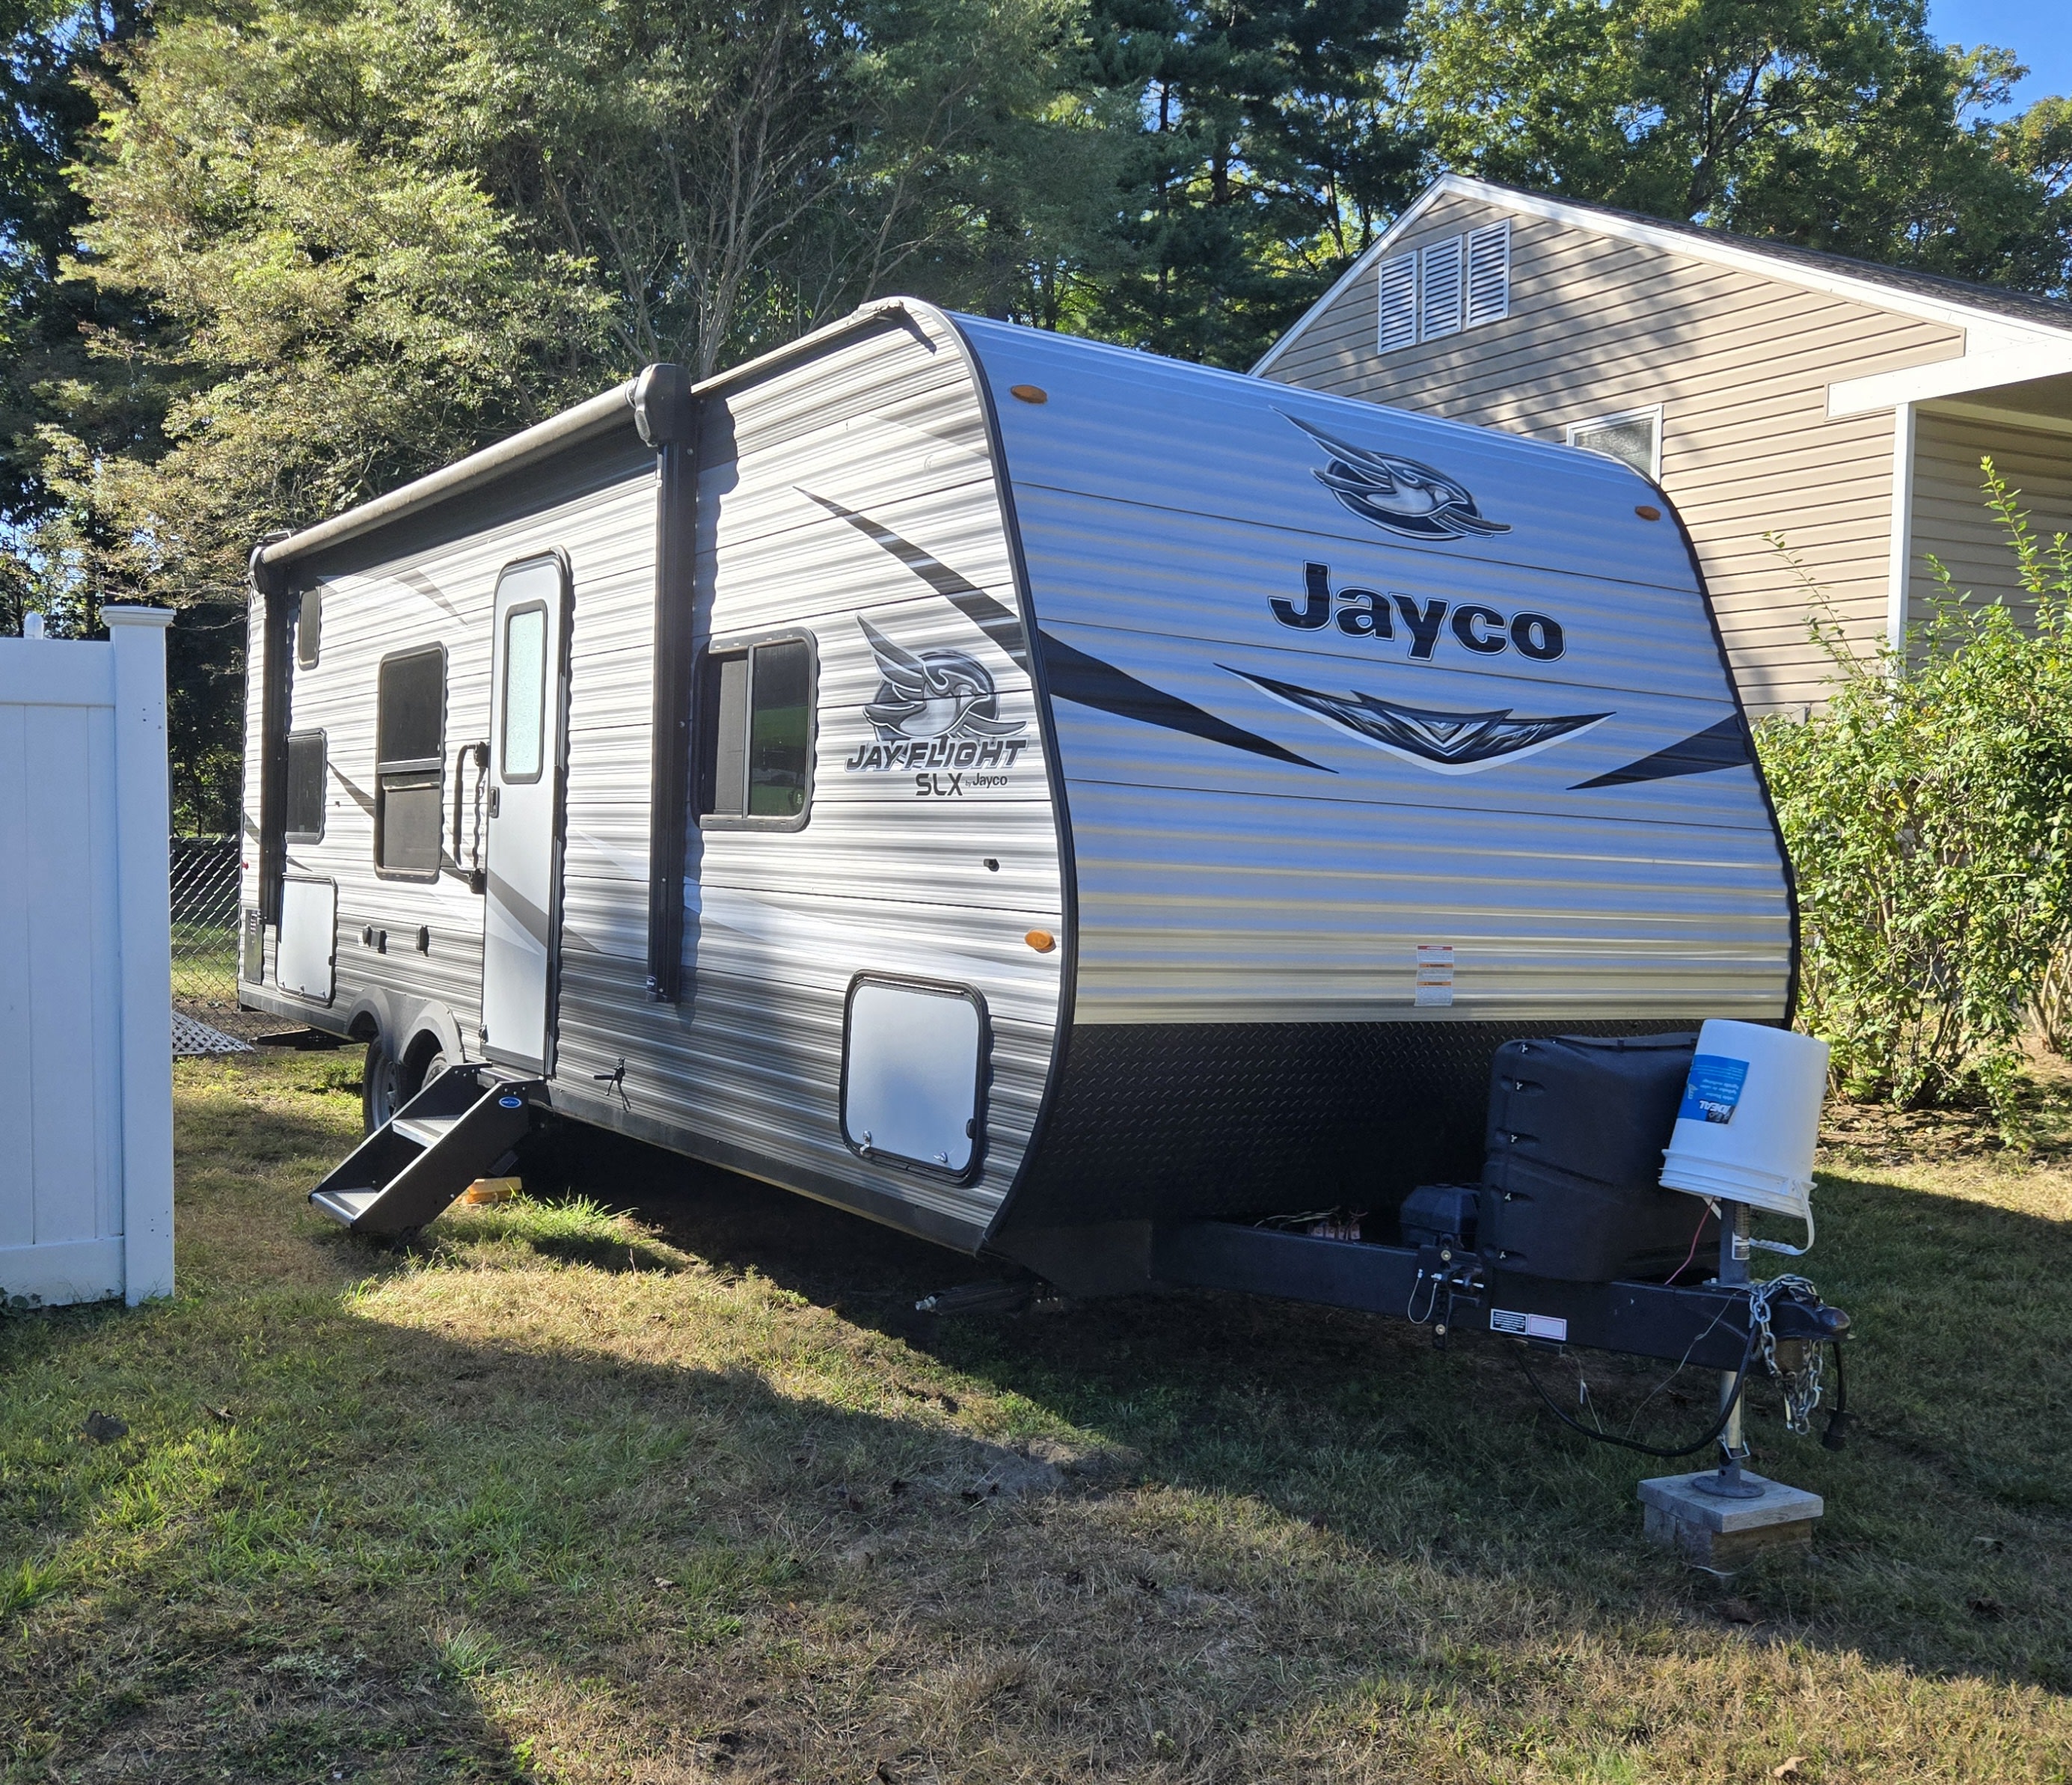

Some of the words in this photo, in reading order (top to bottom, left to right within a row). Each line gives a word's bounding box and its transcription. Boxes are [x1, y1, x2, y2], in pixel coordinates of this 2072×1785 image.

[1269, 560, 1566, 661] Jayco
[915, 772, 963, 796] SLX
[972, 772, 1008, 789] Jayco
[1699, 1100, 1731, 1115] IDEAL
